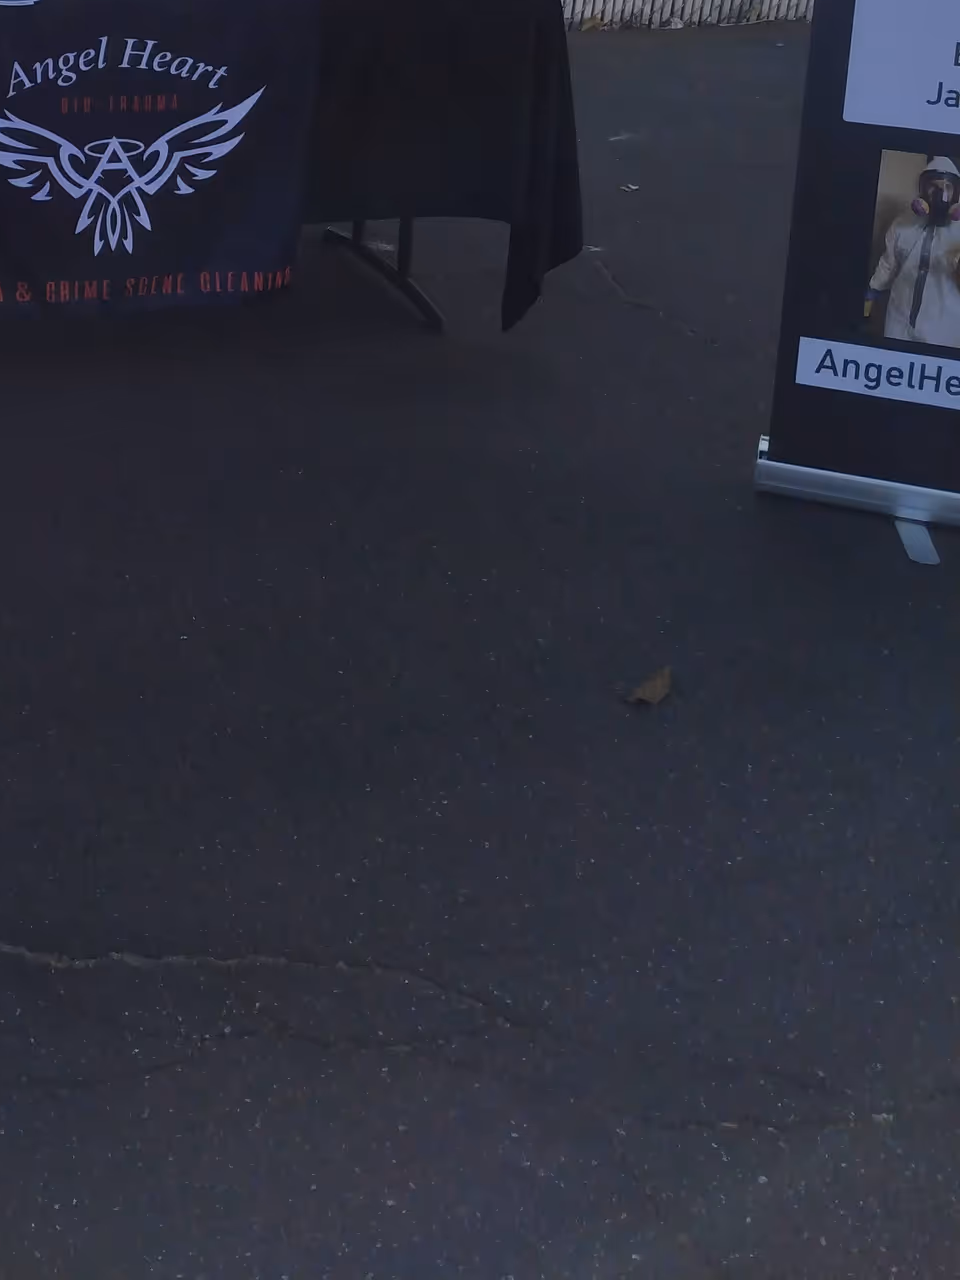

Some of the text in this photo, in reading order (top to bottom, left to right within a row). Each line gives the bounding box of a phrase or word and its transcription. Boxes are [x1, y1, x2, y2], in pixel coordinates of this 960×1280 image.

[6, 35, 228, 99] Angel Heart
[15, 280, 32, 303] &
[46, 279, 111, 304] CRIME
[124, 273, 185, 297] SCENE
